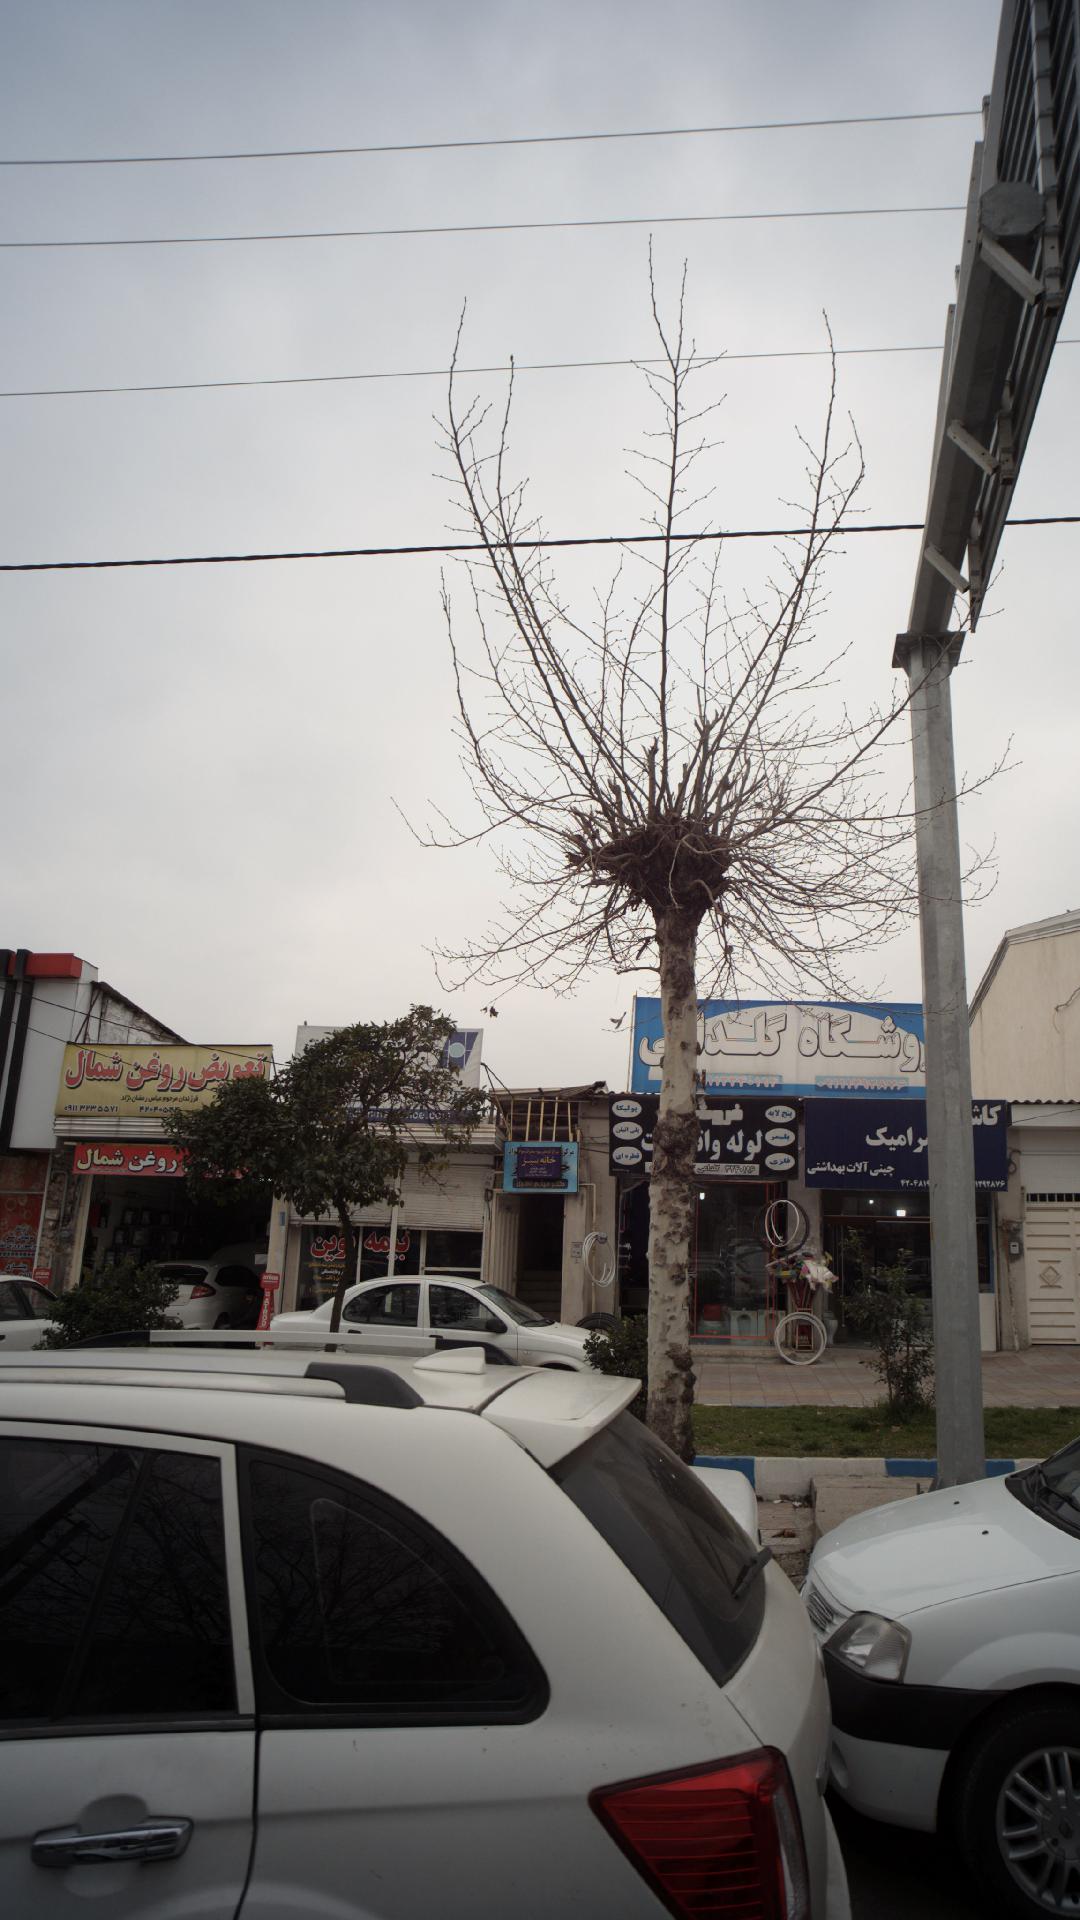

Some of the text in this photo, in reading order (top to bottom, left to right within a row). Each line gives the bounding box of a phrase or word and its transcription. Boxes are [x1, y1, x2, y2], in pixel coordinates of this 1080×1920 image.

[798, 1012, 926, 1072] وشگاه
[65, 1050, 266, 1091] تعویض روغن شمال
[971, 1104, 1001, 1126] کاش
[726, 1128, 763, 1161] لوله
[77, 1149, 124, 1171] شمال
[128, 1150, 178, 1173] روغن
[807, 1160, 895, 1177] چینی آلات بهداشتی
[310, 1230, 411, 1261] بیمه وین
